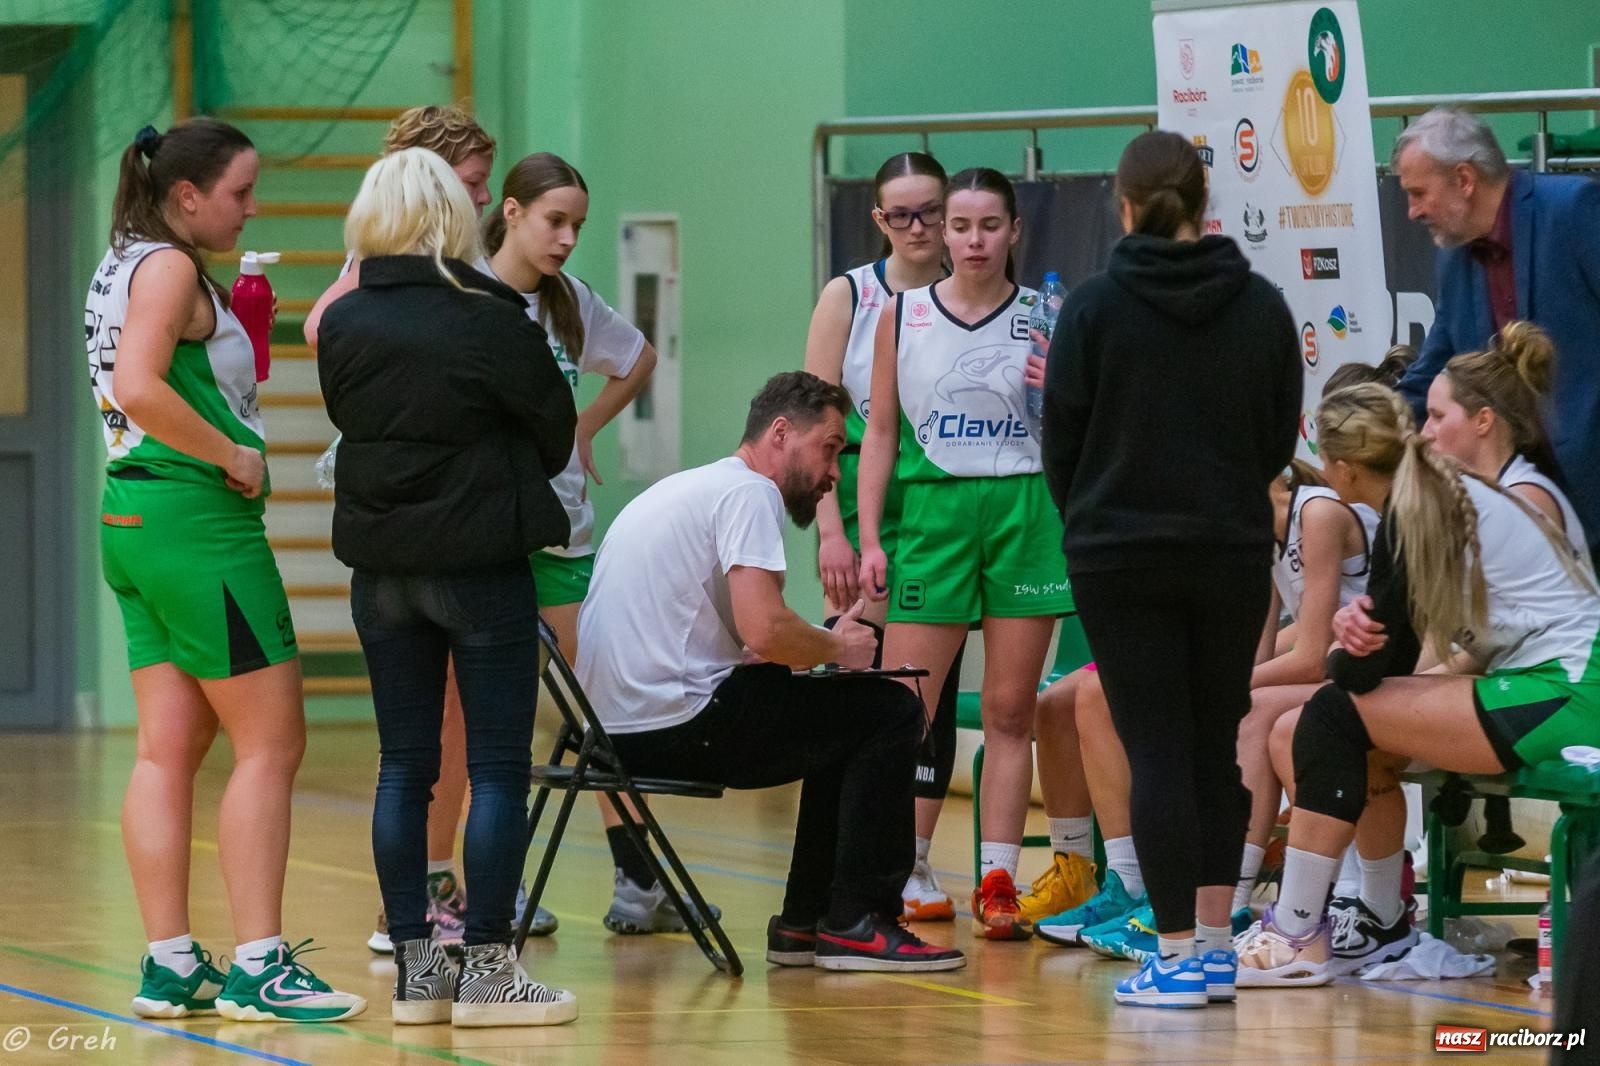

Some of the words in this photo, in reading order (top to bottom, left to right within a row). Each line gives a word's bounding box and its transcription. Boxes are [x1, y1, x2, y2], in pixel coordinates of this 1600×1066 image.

[939, 413, 1029, 438] Clavis
[899, 579, 927, 610] 8
[915, 765, 935, 782] NBA
